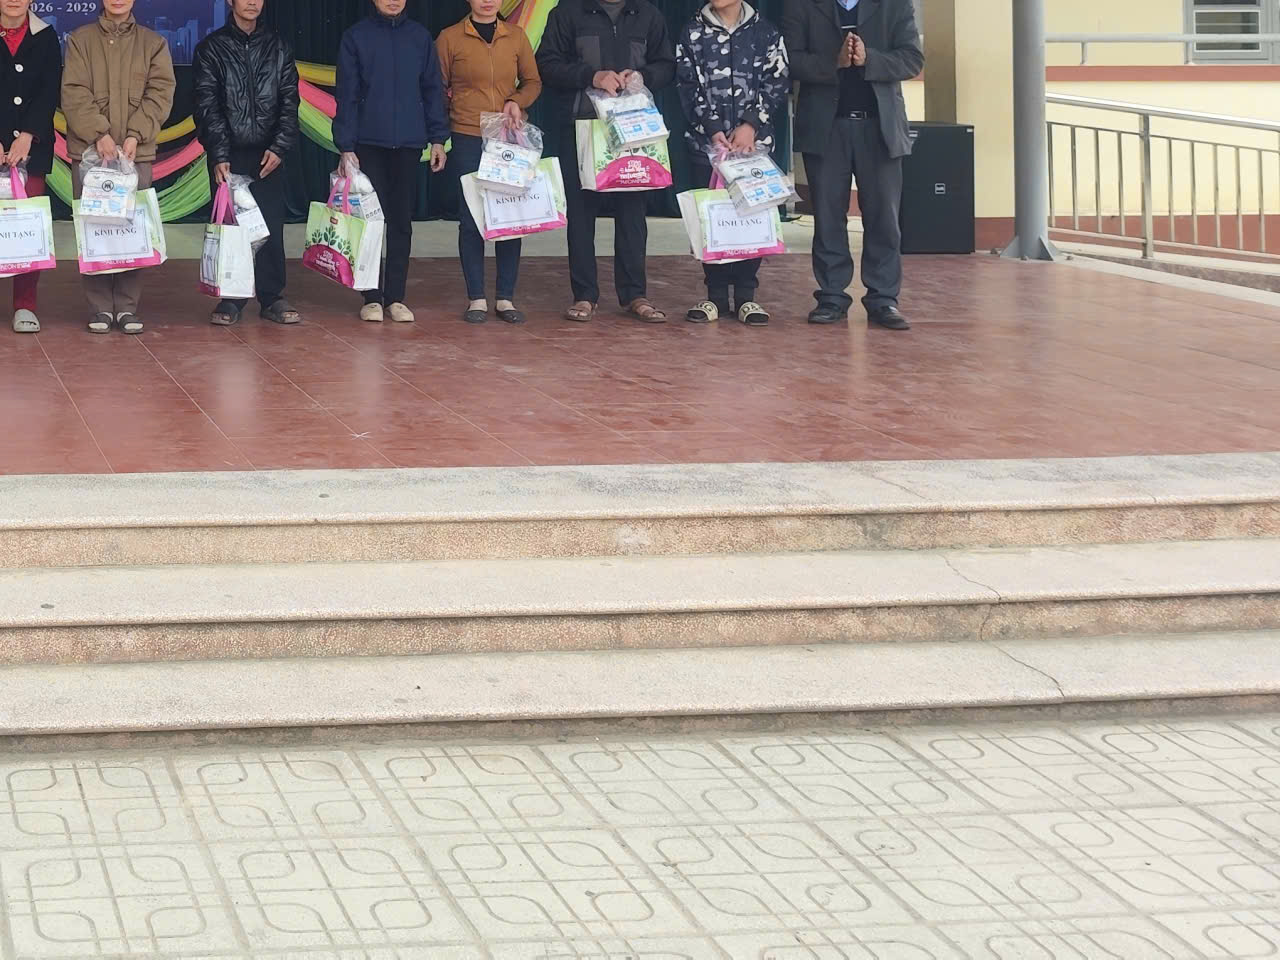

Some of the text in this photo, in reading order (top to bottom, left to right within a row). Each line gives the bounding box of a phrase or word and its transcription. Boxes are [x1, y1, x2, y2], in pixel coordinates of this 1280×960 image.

[31, 2, 53, 13] 026
[66, 2, 96, 13] 2029
[11, 229, 35, 240] TẶNG
